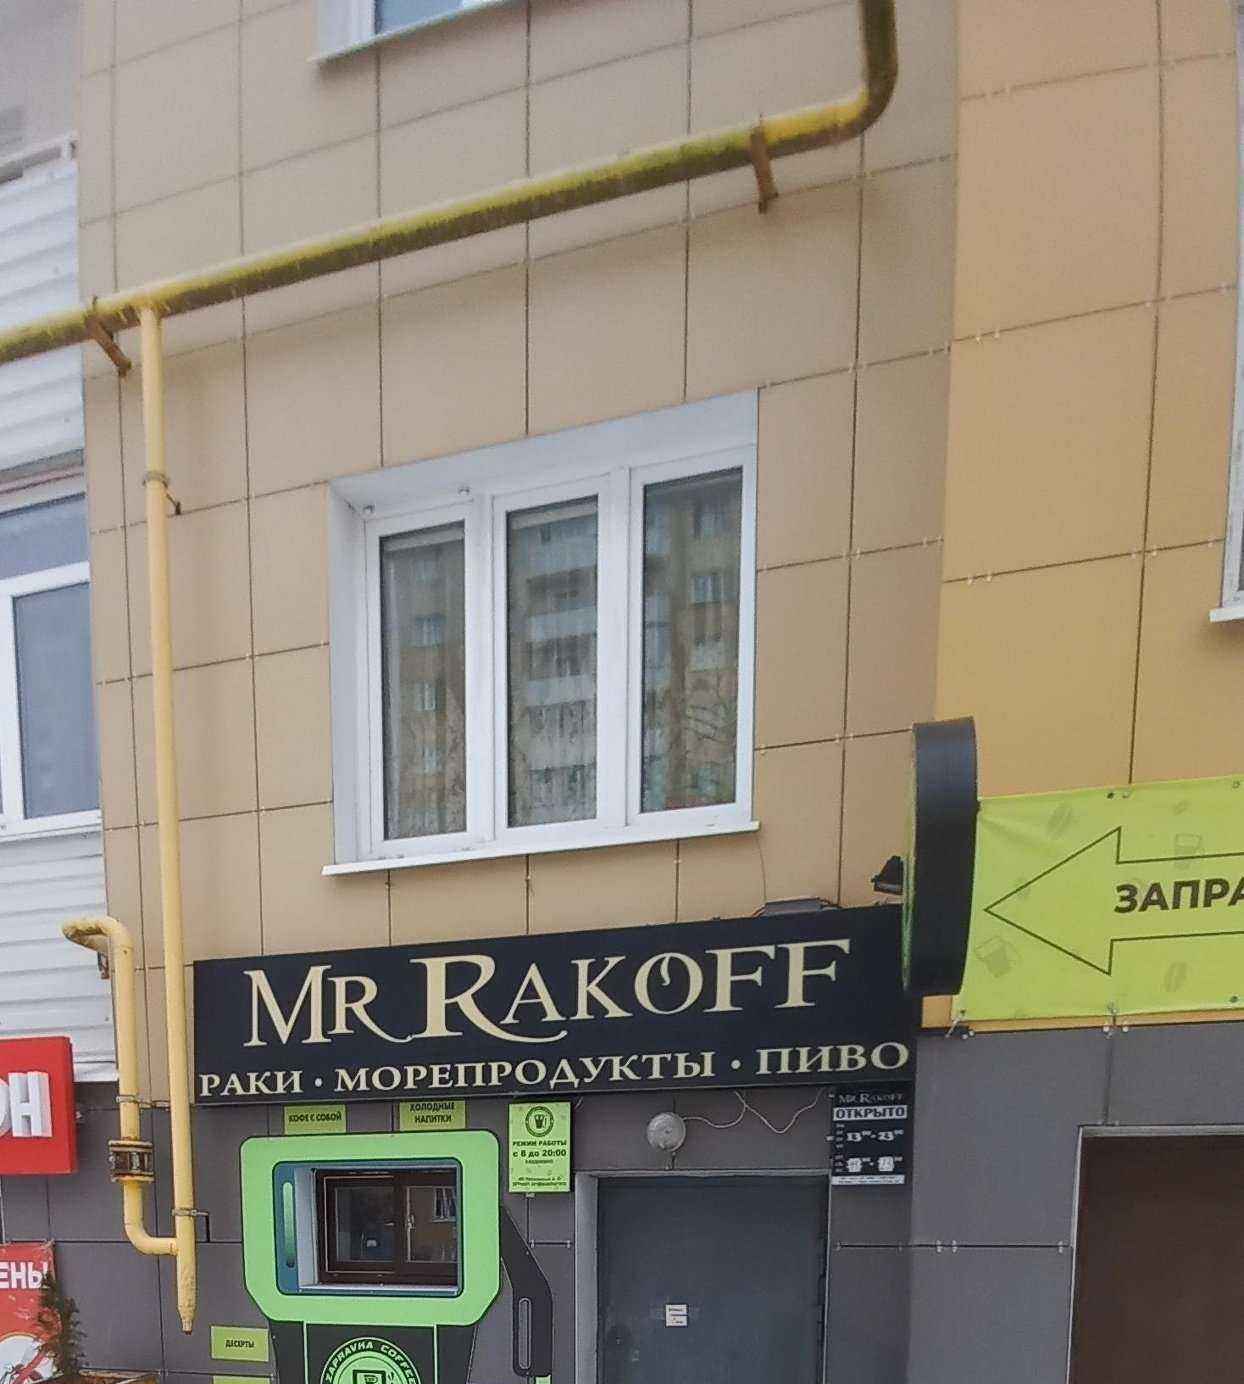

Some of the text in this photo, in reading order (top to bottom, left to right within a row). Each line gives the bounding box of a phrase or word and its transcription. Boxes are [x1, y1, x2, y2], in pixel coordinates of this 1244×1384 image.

[200, 1042, 909, 1097] РАКИ МОРЕПРОДУКТЫ ПИВО
[410, 1101, 455, 1112] ХОЛОДНЫЕ
[317, 1110, 342, 1122] СОБОЙ
[836, 1106, 905, 1119] ОТКРЫТО
[414, 1114, 452, 1124] НАПИТКИ
[528, 1150, 540, 1158] до
[542, 1148, 567, 1157] 20:00
